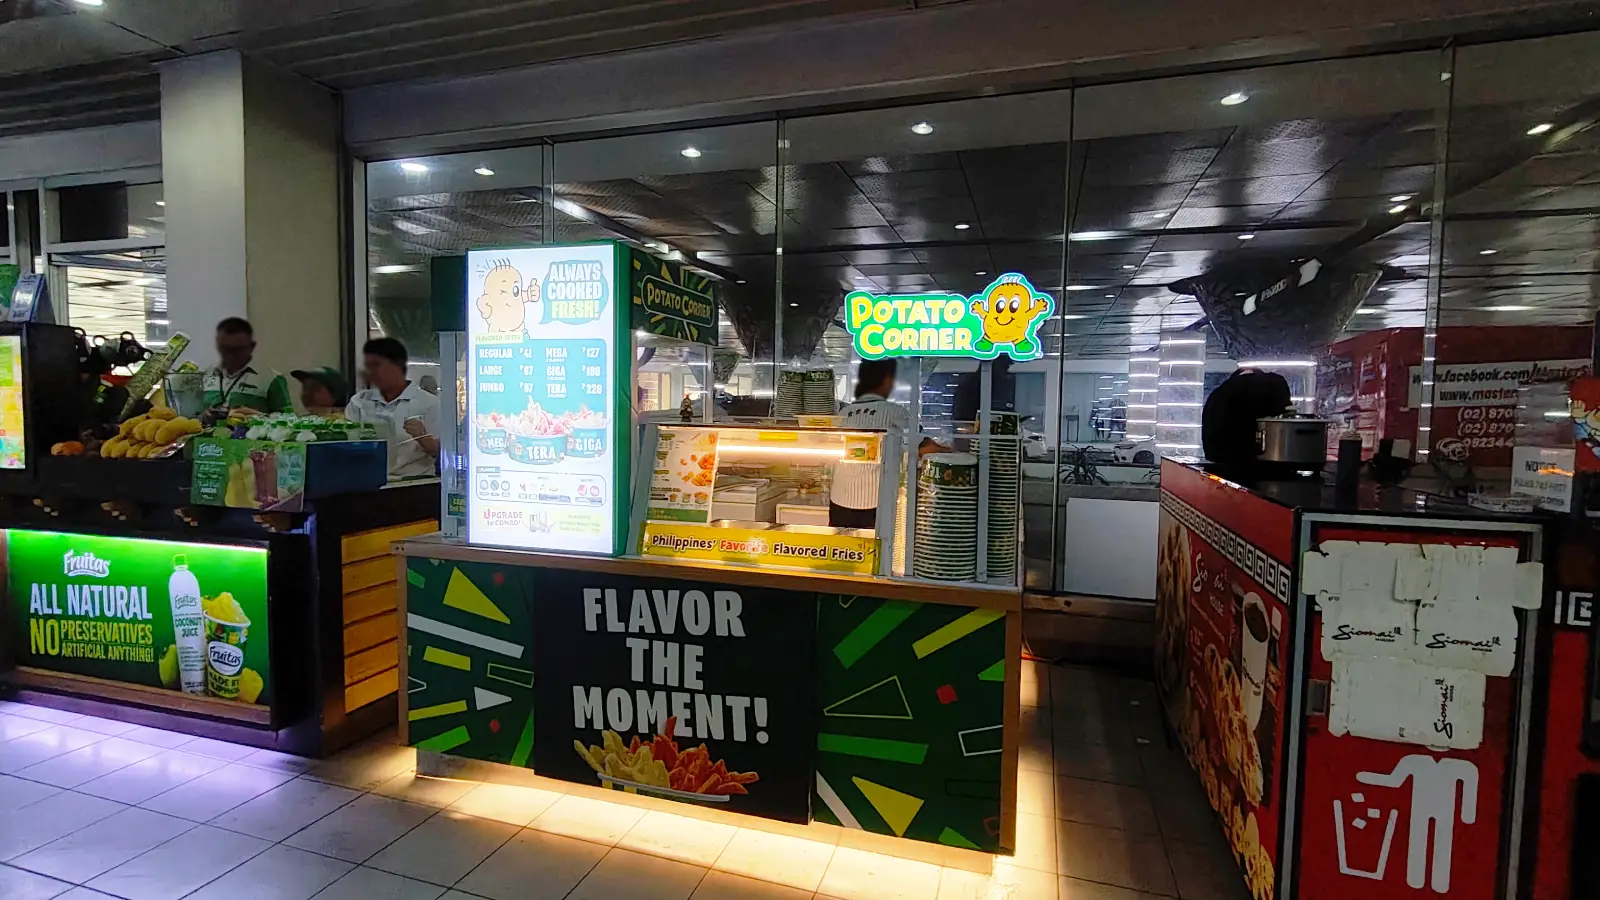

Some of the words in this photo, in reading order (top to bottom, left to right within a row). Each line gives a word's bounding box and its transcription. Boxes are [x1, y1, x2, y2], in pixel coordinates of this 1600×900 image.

[549, 263, 601, 282] ALWAYS
[547, 281, 603, 300] COOKED
[551, 300, 600, 319] FRESH!
[647, 283, 681, 310] POTATO
[682, 295, 711, 318] CORNER
[851, 296, 966, 329] POTATO
[859, 323, 973, 354] CORNER
[479, 348, 513, 359] REGULAR
[545, 347, 567, 358] MEGA
[479, 365, 503, 375] LARGE
[546, 365, 566, 376] GIGA
[479, 382, 505, 393] JUMBO
[547, 383, 567, 394] TERA
[1458, 406, 1486, 422] (02)
[1458, 421, 1487, 436] (02)
[527, 445, 556, 460] TERA
[575, 437, 602, 452] GIGA
[484, 508, 523, 520] UPGRADE
[652, 534, 717, 551] Philippines'
[773, 543, 827, 558] Flavored
[831, 547, 864, 561] Fries
[64, 549, 110, 578] Fruitas
[30, 583, 62, 615] ALL
[67, 584, 153, 620] NATURAL
[583, 587, 746, 637] FLAVOR
[175, 616, 203, 628] COCONUT
[30, 618, 59, 655] NO
[60, 620, 153, 645] PRESERVATIVES
[181, 627, 199, 638] JUICE
[1332, 624, 1394, 640] Siomai
[1425, 633, 1493, 648] Siomai
[61, 643, 105, 660] ARTIFICIAL
[107, 643, 154, 663] ANYTHING!
[210, 646, 242, 667] Fruitas
[626, 637, 704, 690] THE
[572, 685, 769, 744] MOMENT!
[1434, 684, 1453, 739] Siomai
